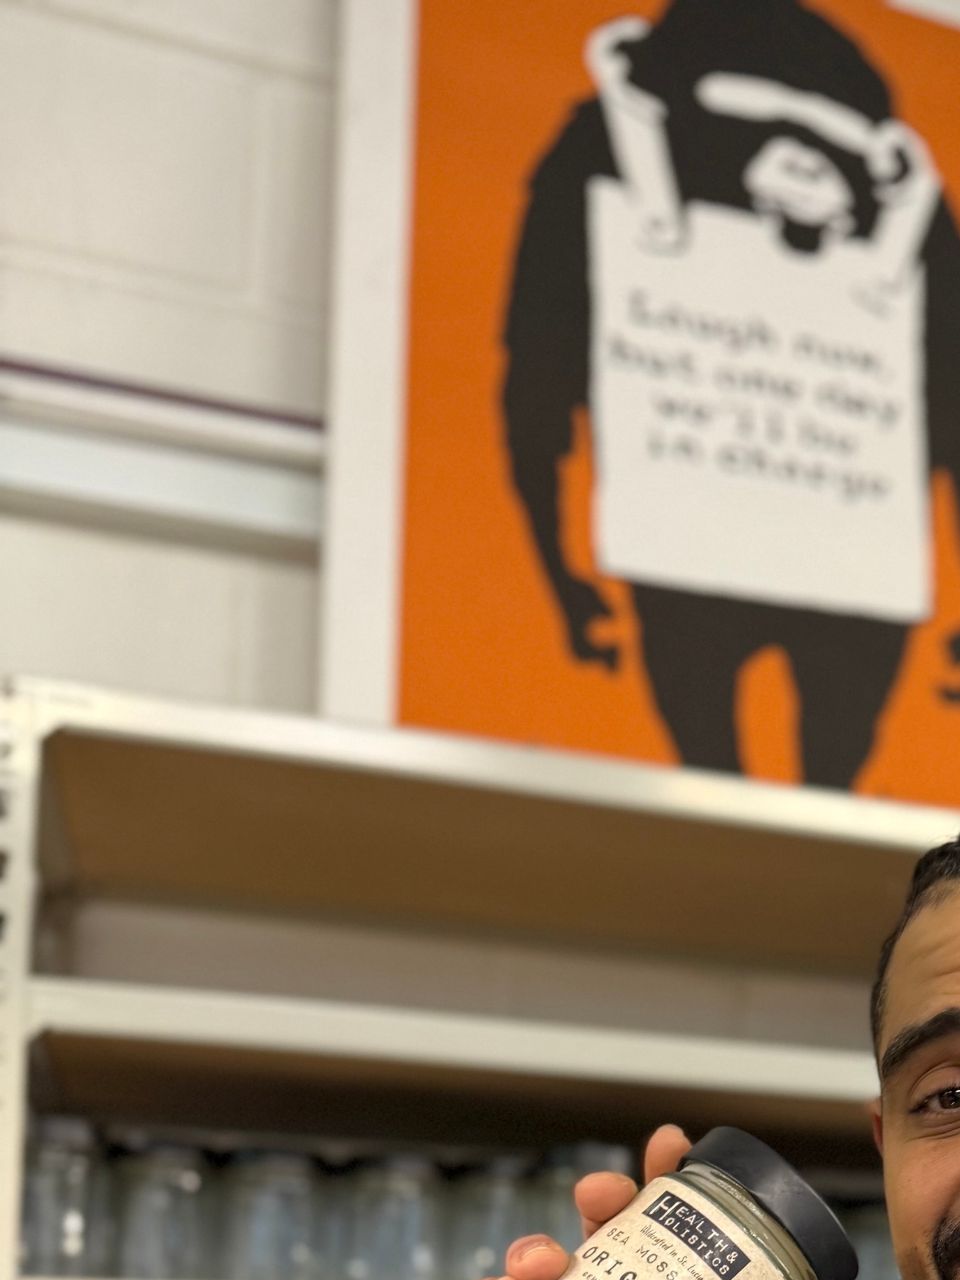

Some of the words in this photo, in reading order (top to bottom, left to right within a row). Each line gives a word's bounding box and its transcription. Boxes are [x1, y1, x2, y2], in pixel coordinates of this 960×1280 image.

[607, 1227, 630, 1246] SEA
[648, 1195, 728, 1253] HEALTH
[726, 1251, 739, 1264] &
